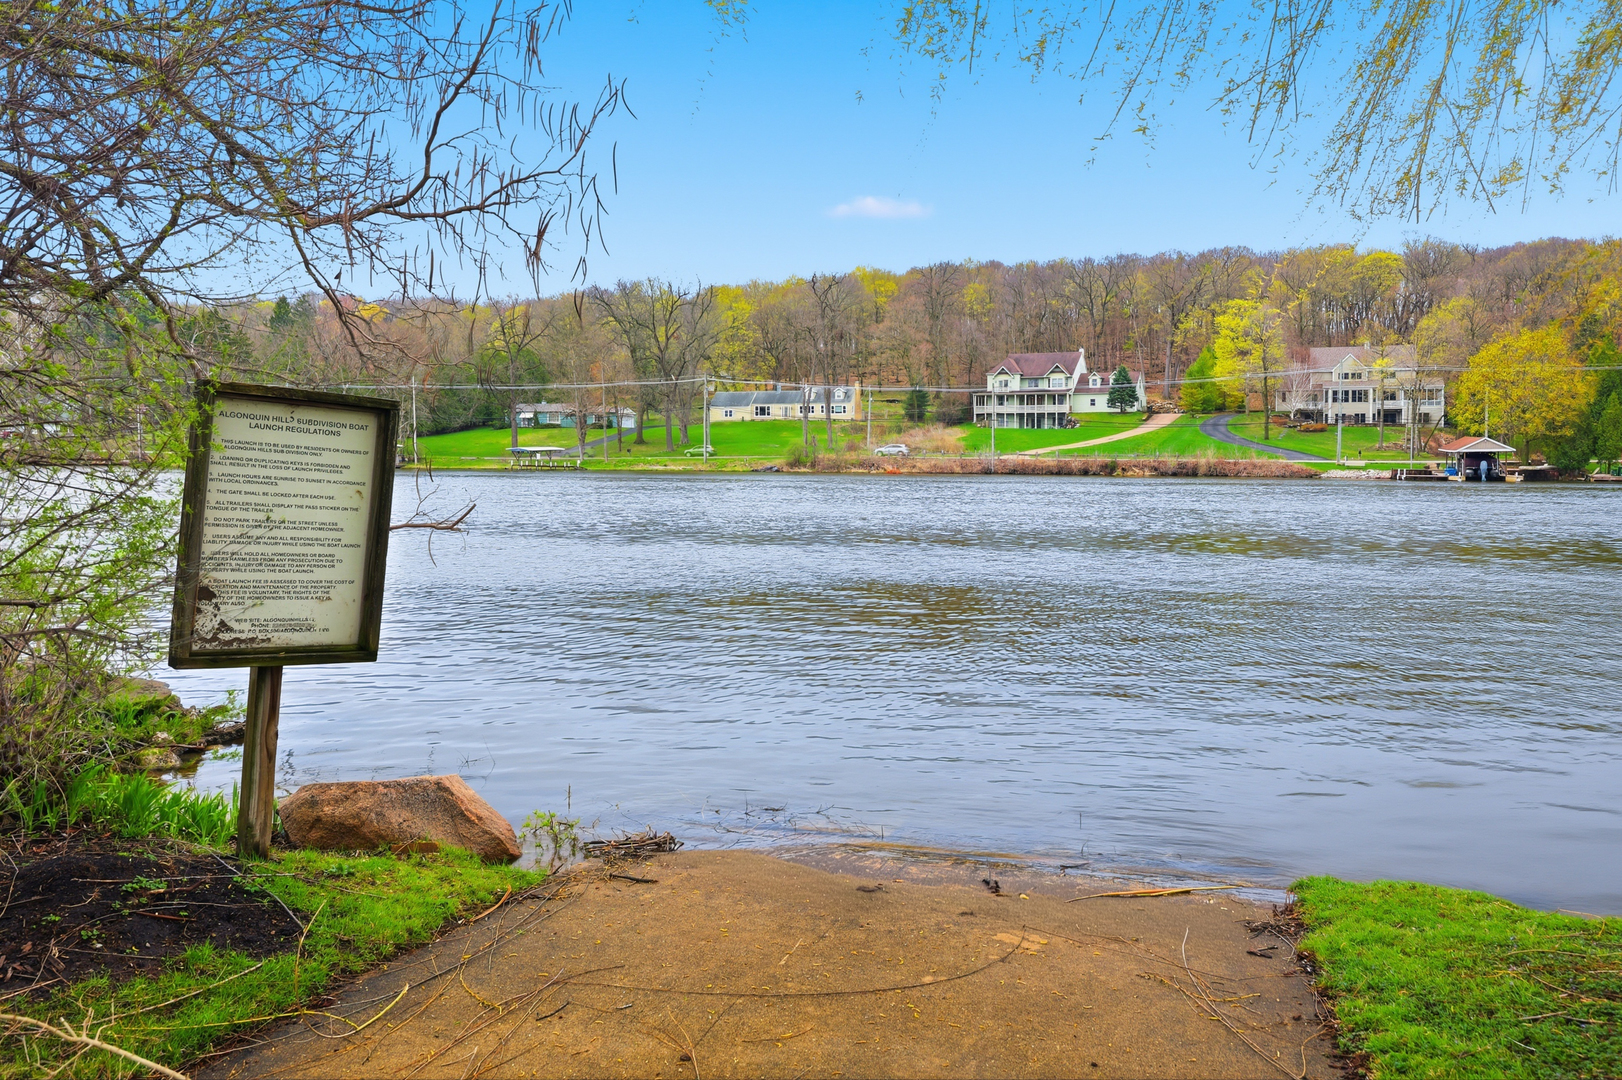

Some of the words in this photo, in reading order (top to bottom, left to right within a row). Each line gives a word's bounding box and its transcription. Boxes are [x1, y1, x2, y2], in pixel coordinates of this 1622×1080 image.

[218, 410, 270, 422] ALGONQUIN
[296, 417, 347, 429] SUBDIVISION
[348, 422, 369, 431] BOAT
[249, 422, 284, 432] LAUNCH
[285, 425, 341, 437] REGULATIONS
[224, 444, 257, 452] ALGONQUIN
